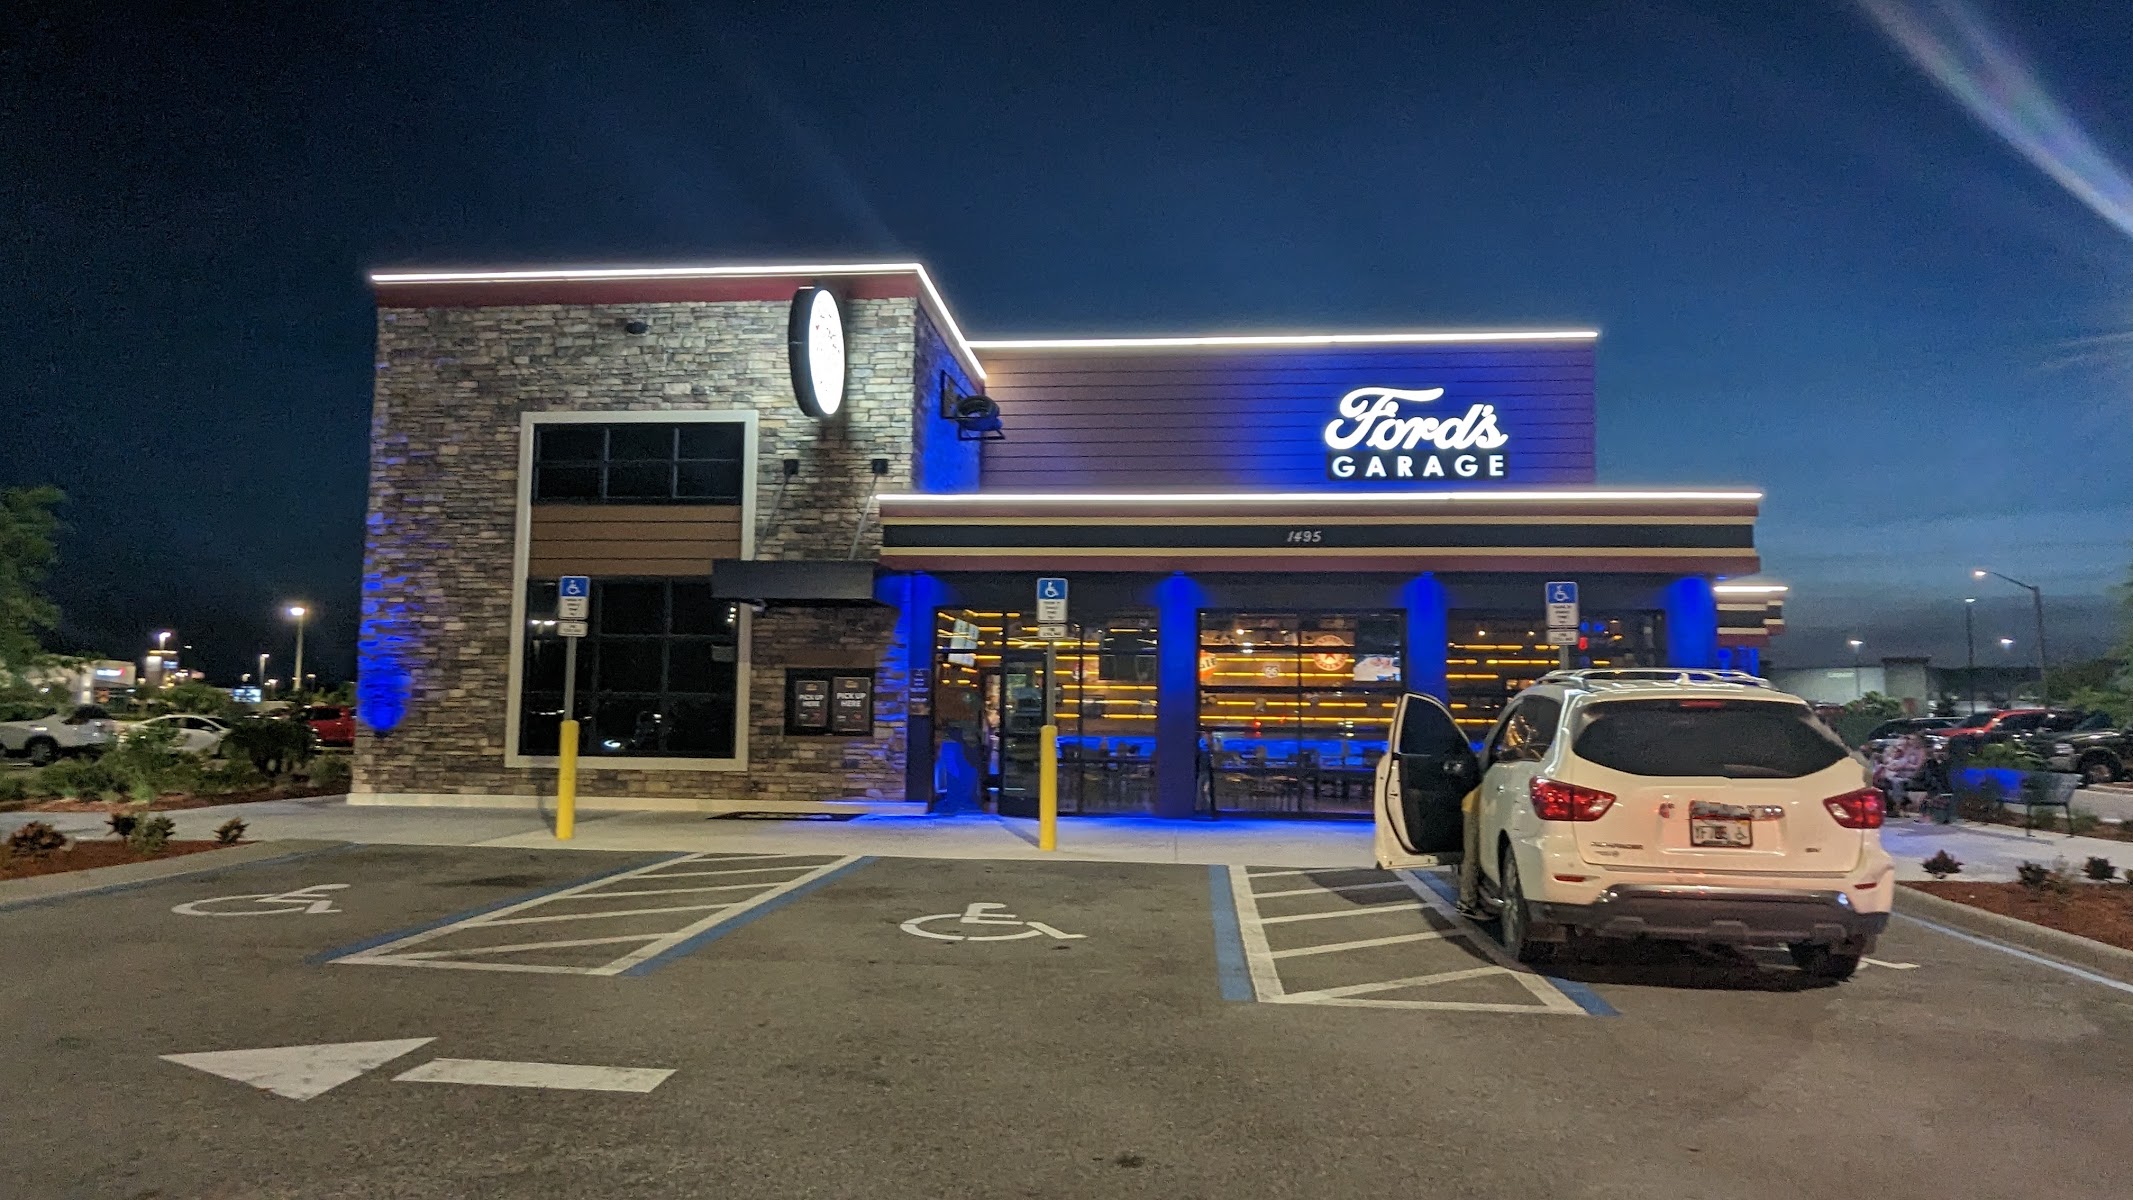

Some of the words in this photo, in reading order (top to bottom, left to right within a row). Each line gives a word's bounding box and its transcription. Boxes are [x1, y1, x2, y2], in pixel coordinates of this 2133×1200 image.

[1324, 386, 1509, 450] Ford's
[1332, 455, 1504, 477] GARAGE
[1287, 531, 1321, 542] 1495
[836, 692, 854, 700] PICK
[855, 692, 867, 700] UP
